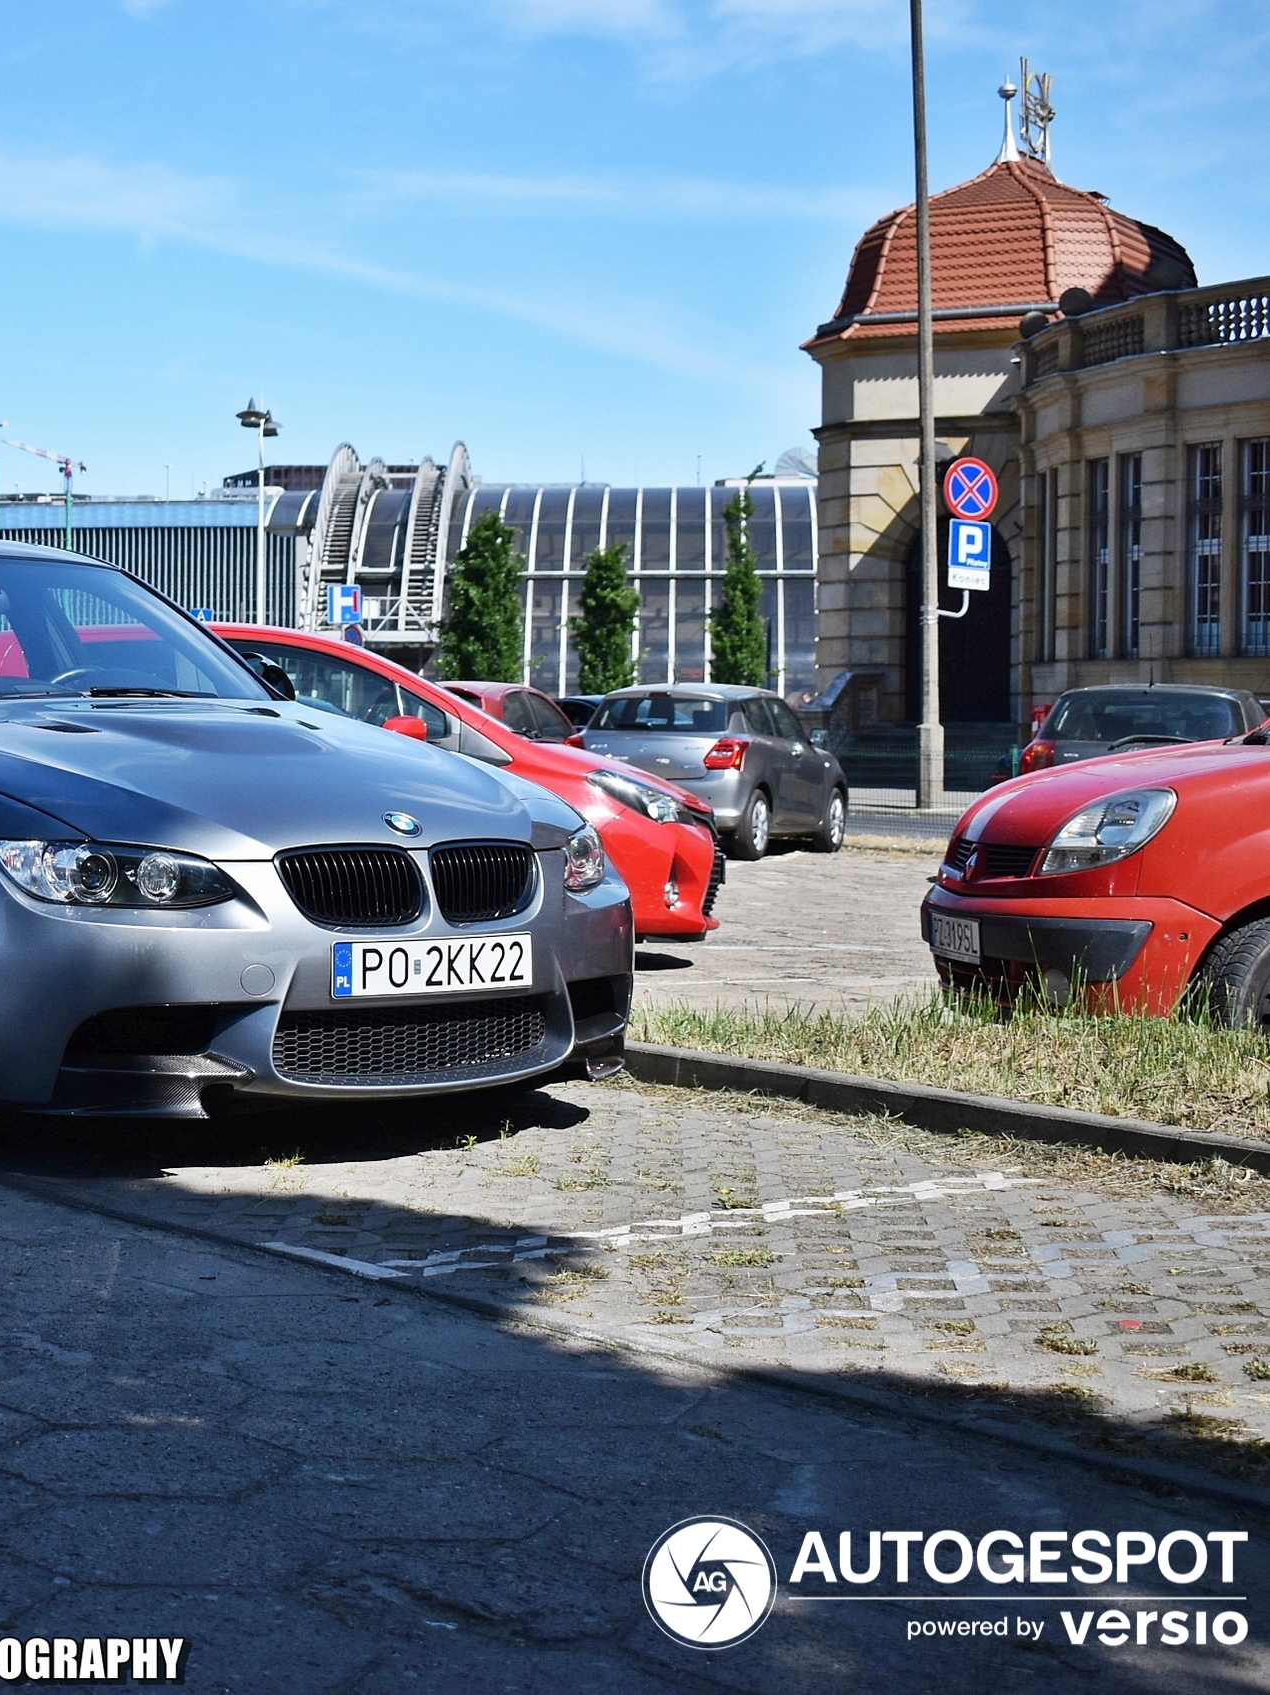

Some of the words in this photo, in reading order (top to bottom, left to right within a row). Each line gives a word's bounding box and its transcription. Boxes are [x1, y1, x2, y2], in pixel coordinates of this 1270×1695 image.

[958, 524, 983, 564] P
[952, 572, 986, 586] Koniec
[361, 947, 409, 990] PO
[424, 940, 525, 987] 2KK22
[336, 975, 351, 989] PL
